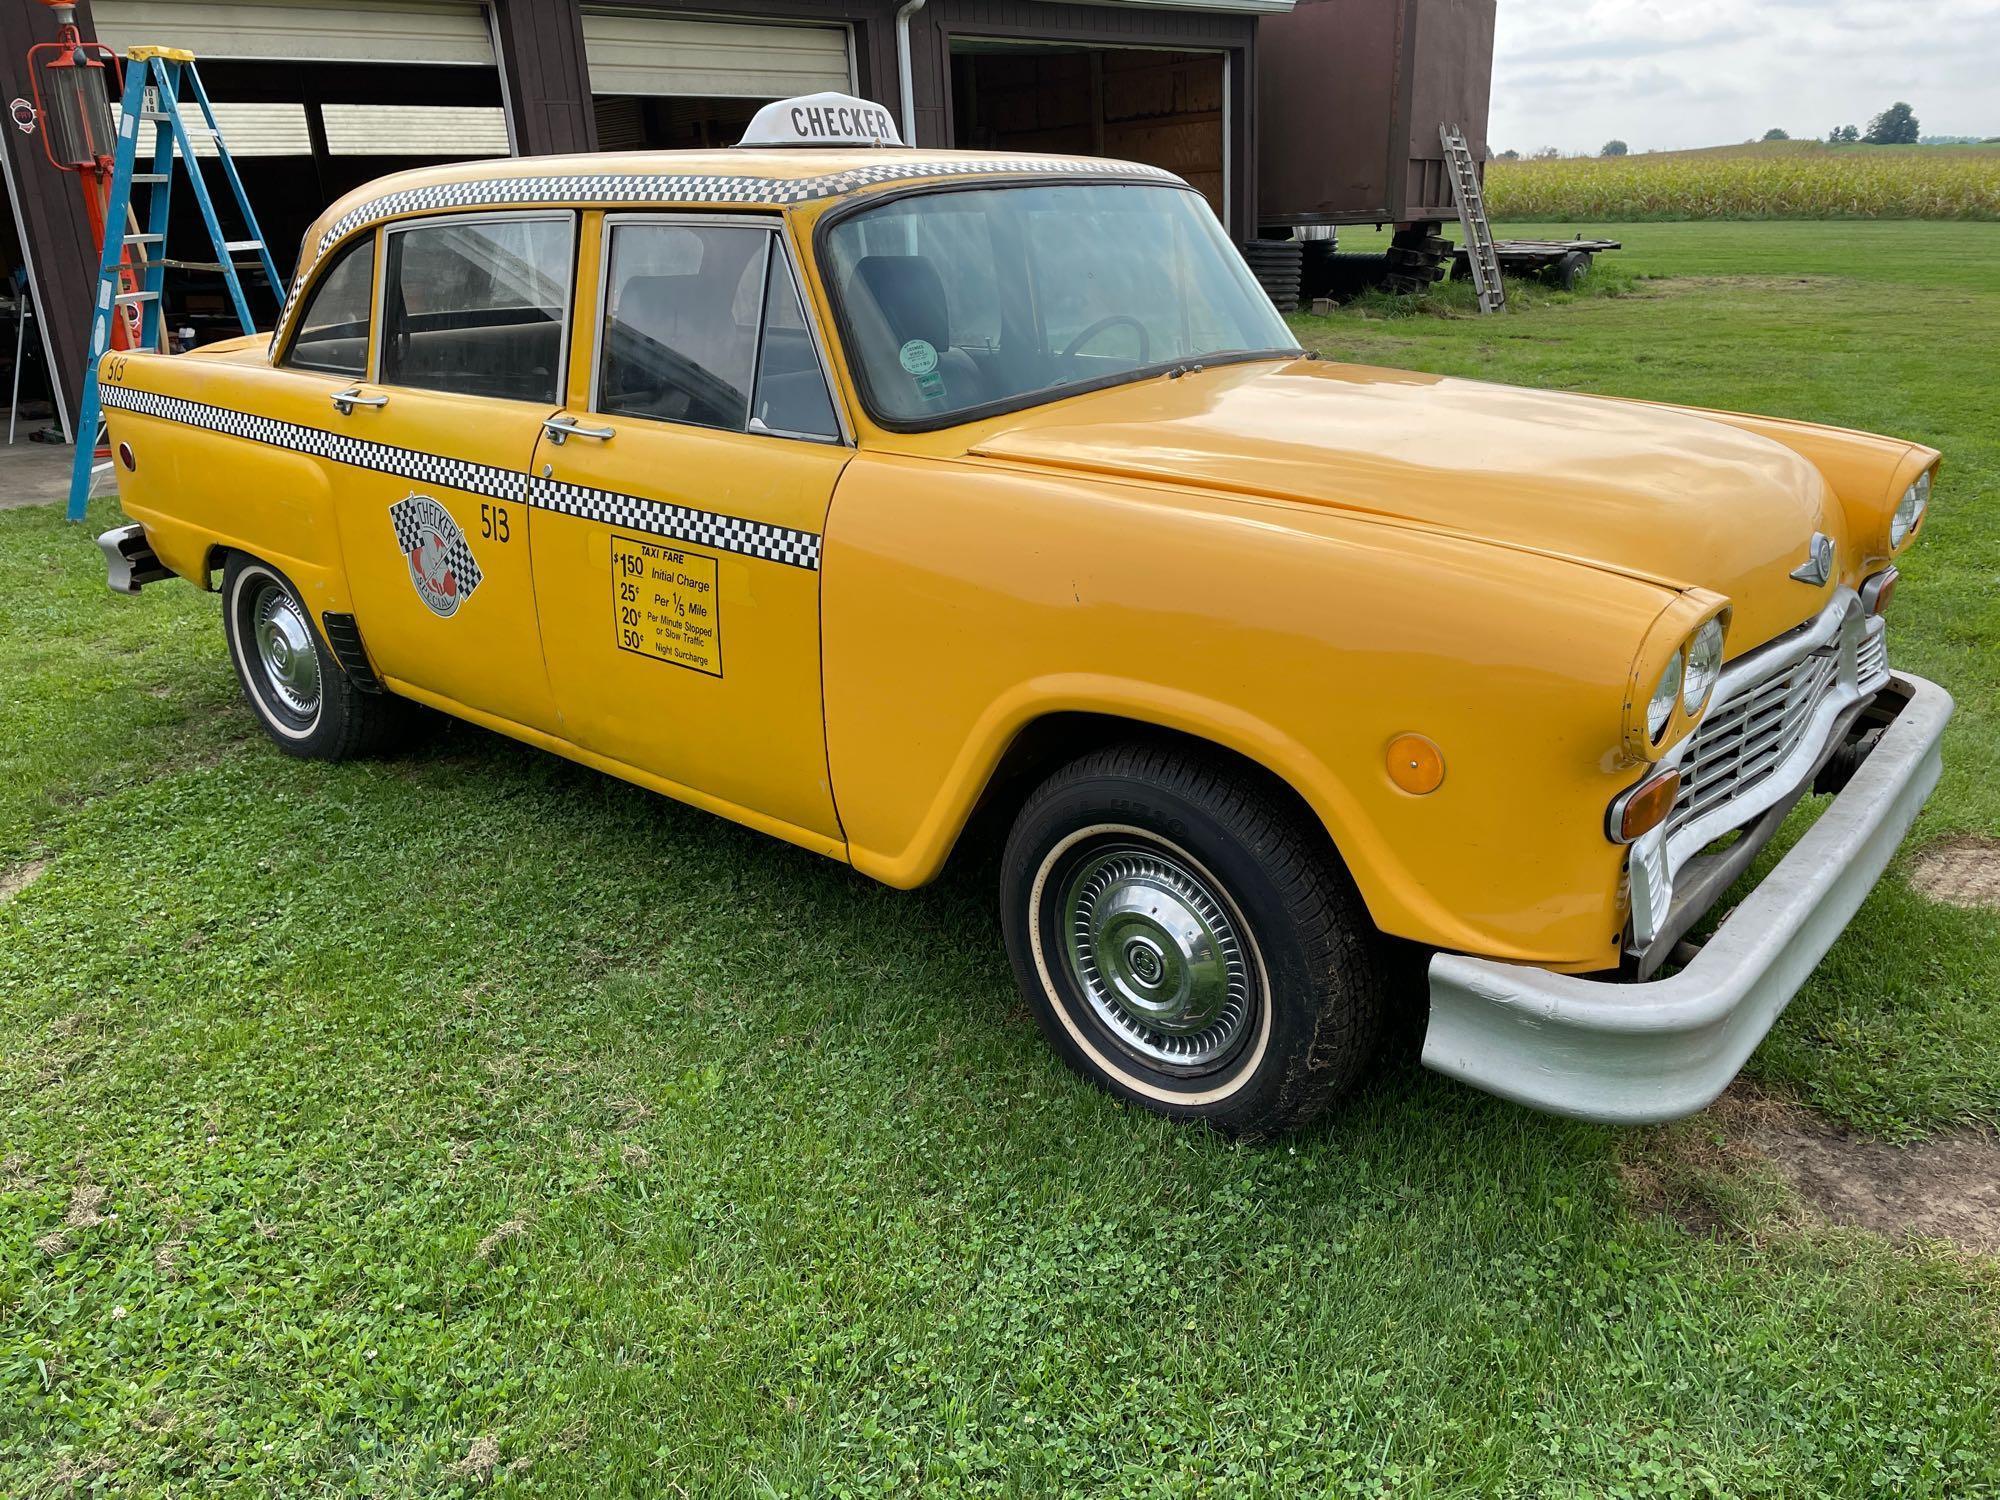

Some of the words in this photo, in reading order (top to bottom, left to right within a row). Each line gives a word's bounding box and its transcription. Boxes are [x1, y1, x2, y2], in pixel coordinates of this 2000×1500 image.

[790, 107, 890, 138] CHECKER
[108, 357, 128, 381] 513
[417, 502, 457, 544] CHECKER
[481, 504, 510, 543] 513
[641, 545, 659, 558] TAXI
[662, 551, 684, 564] FARE
[652, 568, 674, 583] Initial
[676, 573, 710, 592] Charge
[654, 594, 669, 607] Per
[688, 603, 707, 617] Mile
[647, 612, 658, 622] Per
[660, 615, 682, 629] Minute
[684, 622, 712, 637] Stopped
[665, 628, 681, 640] Slow
[683, 633, 704, 647] Traffic
[655, 642, 672, 655] Night
[674, 648, 708, 666] Surcharge
